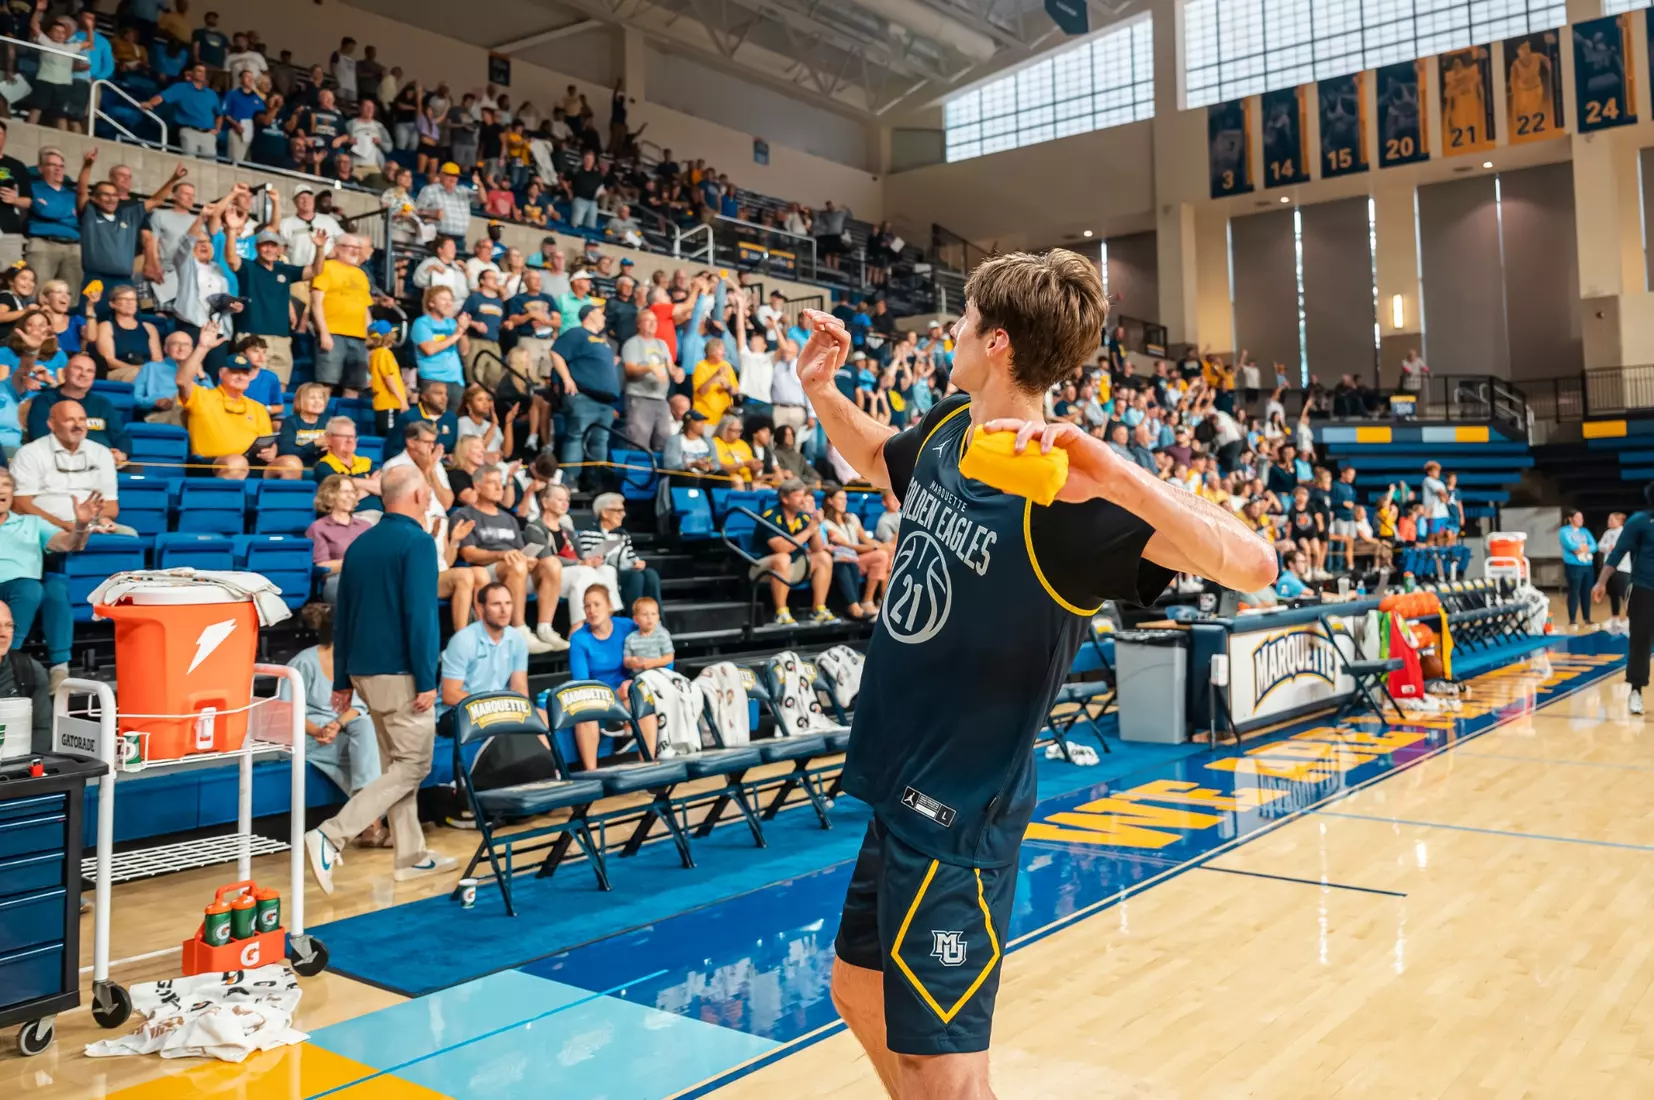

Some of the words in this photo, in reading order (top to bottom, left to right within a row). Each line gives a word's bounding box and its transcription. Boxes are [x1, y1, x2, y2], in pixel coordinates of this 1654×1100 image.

[1585, 97, 1620, 125] 24
[1516, 112, 1546, 136] 22
[1385, 136, 1415, 160] 20
[1451, 126, 1476, 148] 21
[1271, 158, 1295, 181] 14
[1327, 147, 1352, 171] 15
[1221, 169, 1234, 190] 3
[929, 480, 968, 512] MARQUETTE
[935, 506, 998, 576] EAGLES
[890, 574, 923, 632] 21
[1254, 631, 1336, 699] MARQUETTE
[470, 700, 529, 720] MARQUETTE
[61, 733, 96, 753] GATORADE
[941, 811, 947, 821] L
[262, 908, 277, 926] G
[216, 922, 231, 940] G
[240, 941, 260, 967] G
[930, 930, 967, 967] MU
